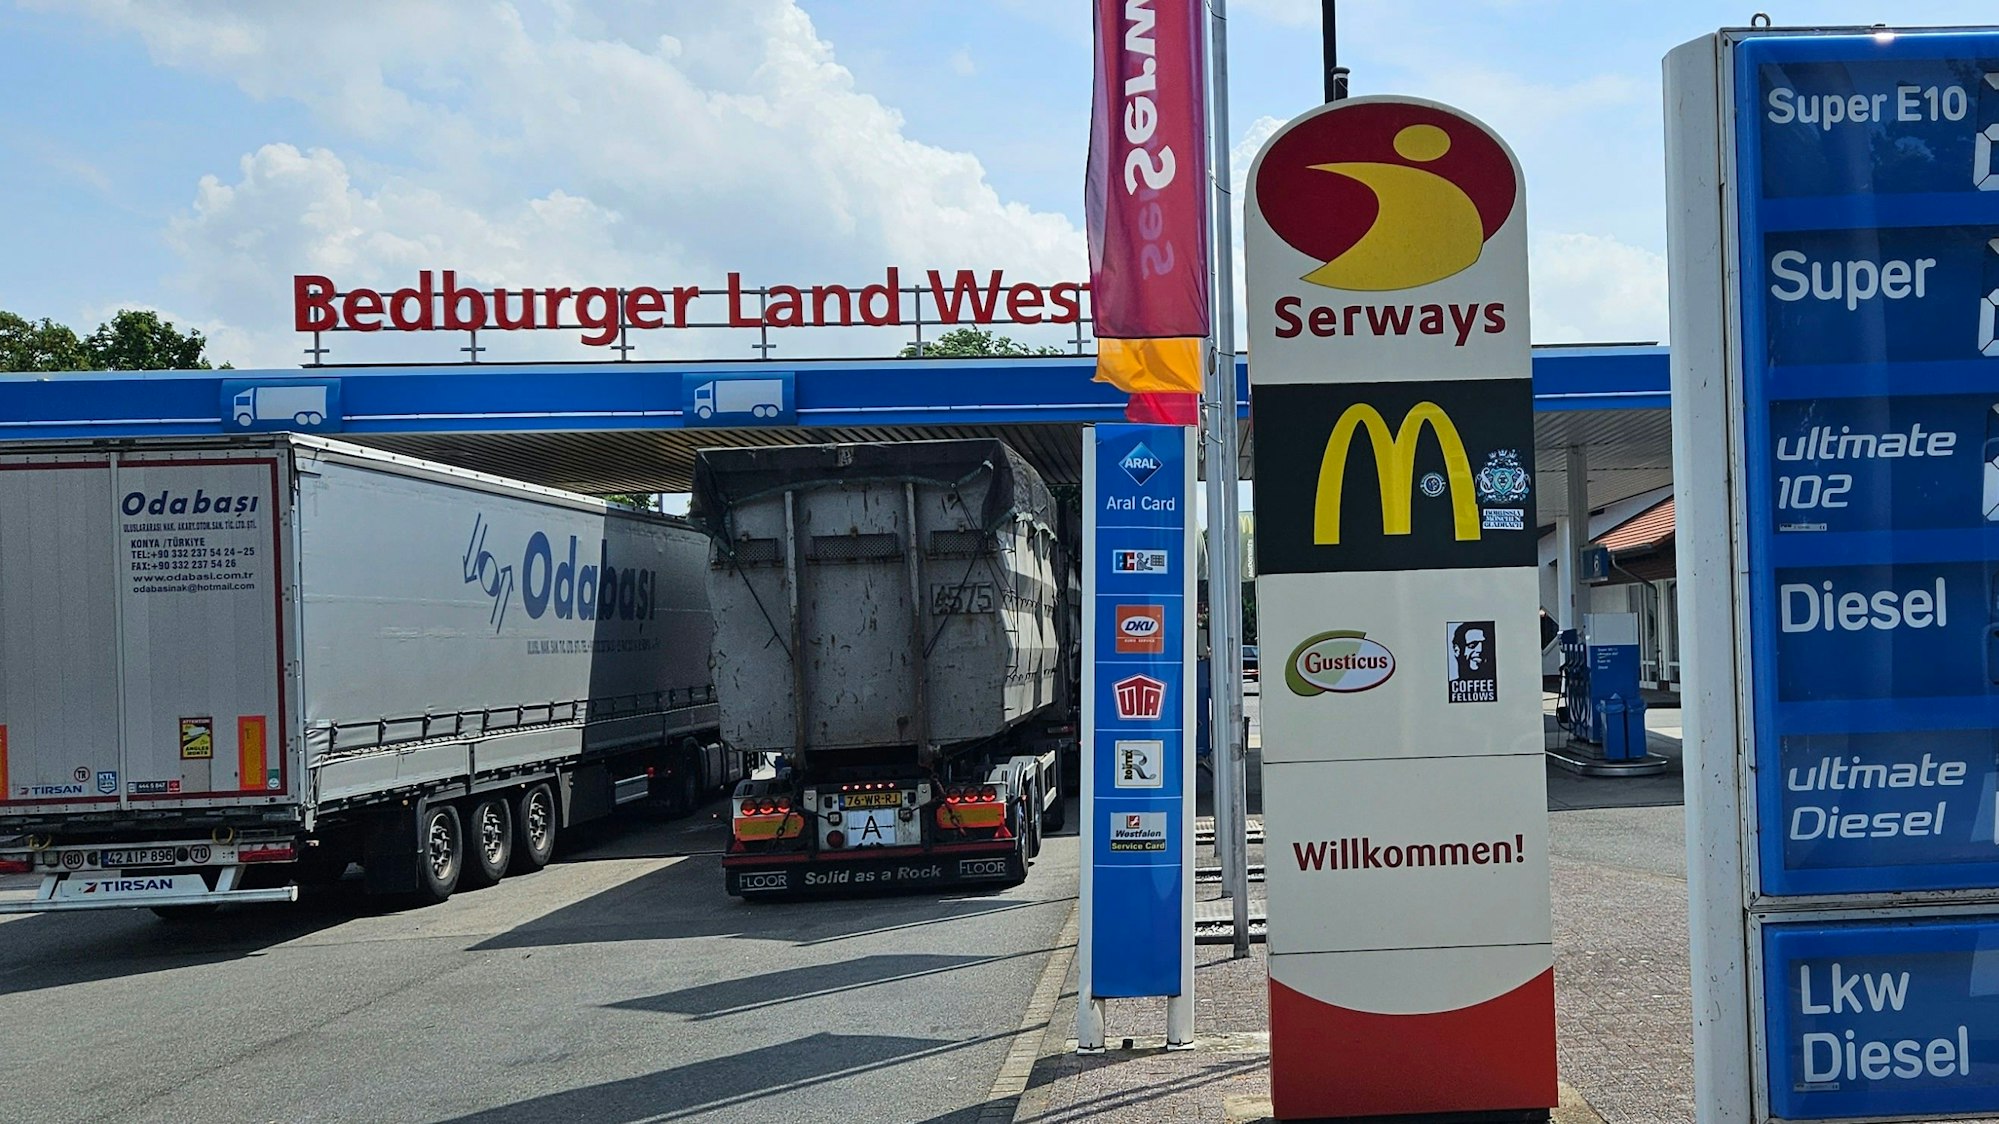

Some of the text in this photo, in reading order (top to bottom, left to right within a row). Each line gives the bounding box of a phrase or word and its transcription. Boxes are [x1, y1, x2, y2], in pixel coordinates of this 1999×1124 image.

[1768, 85, 1968, 131] Super E10
[1771, 250, 1936, 311] Super
[294, 266, 1091, 346] Bedburger Land Wes
[1275, 296, 1506, 347] Serways
[1777, 422, 1957, 461] ultimate
[1125, 457, 1157, 469] ARAL
[1778, 474, 1853, 510] 102
[122, 489, 259, 518] Odabaşı
[1106, 496, 1175, 511] Aral Card
[131, 539, 160, 549] KONYA
[172, 550, 188, 558] 332
[191, 550, 207, 558] 237
[210, 549, 222, 557] 54
[172, 560, 189, 570] 332
[192, 560, 208, 569] 237
[211, 559, 223, 568] 54
[225, 559, 236, 568] 26
[1781, 576, 1947, 633] Diesel
[1125, 621, 1155, 631] DKV
[1304, 652, 1388, 674] Gusticus
[1451, 679, 1494, 693] COFFEE
[1117, 677, 1162, 716] UTA
[1451, 692, 1495, 702] FELLOWS
[77, 770, 87, 780] TR
[1788, 753, 1967, 792] ultimate
[32, 785, 82, 795] TIRSAN
[861, 815, 882, 841] A
[1789, 801, 1947, 840] Diesel
[1115, 829, 1162, 838] Westfalen
[194, 848, 207, 859] 70
[1112, 842, 1165, 850] Service Card
[1293, 834, 1524, 871] Willkommen!
[66, 854, 80, 865] 80
[108, 850, 173, 864] 42 AIP 896
[805, 865, 942, 885] Solid as a Rock
[959, 859, 1006, 876] FLOOR
[101, 878, 173, 892] TIRSAN
[739, 873, 787, 888] FLOOR
[1800, 963, 1910, 1014] Lkw
[1803, 1025, 1969, 1083] Diesel
